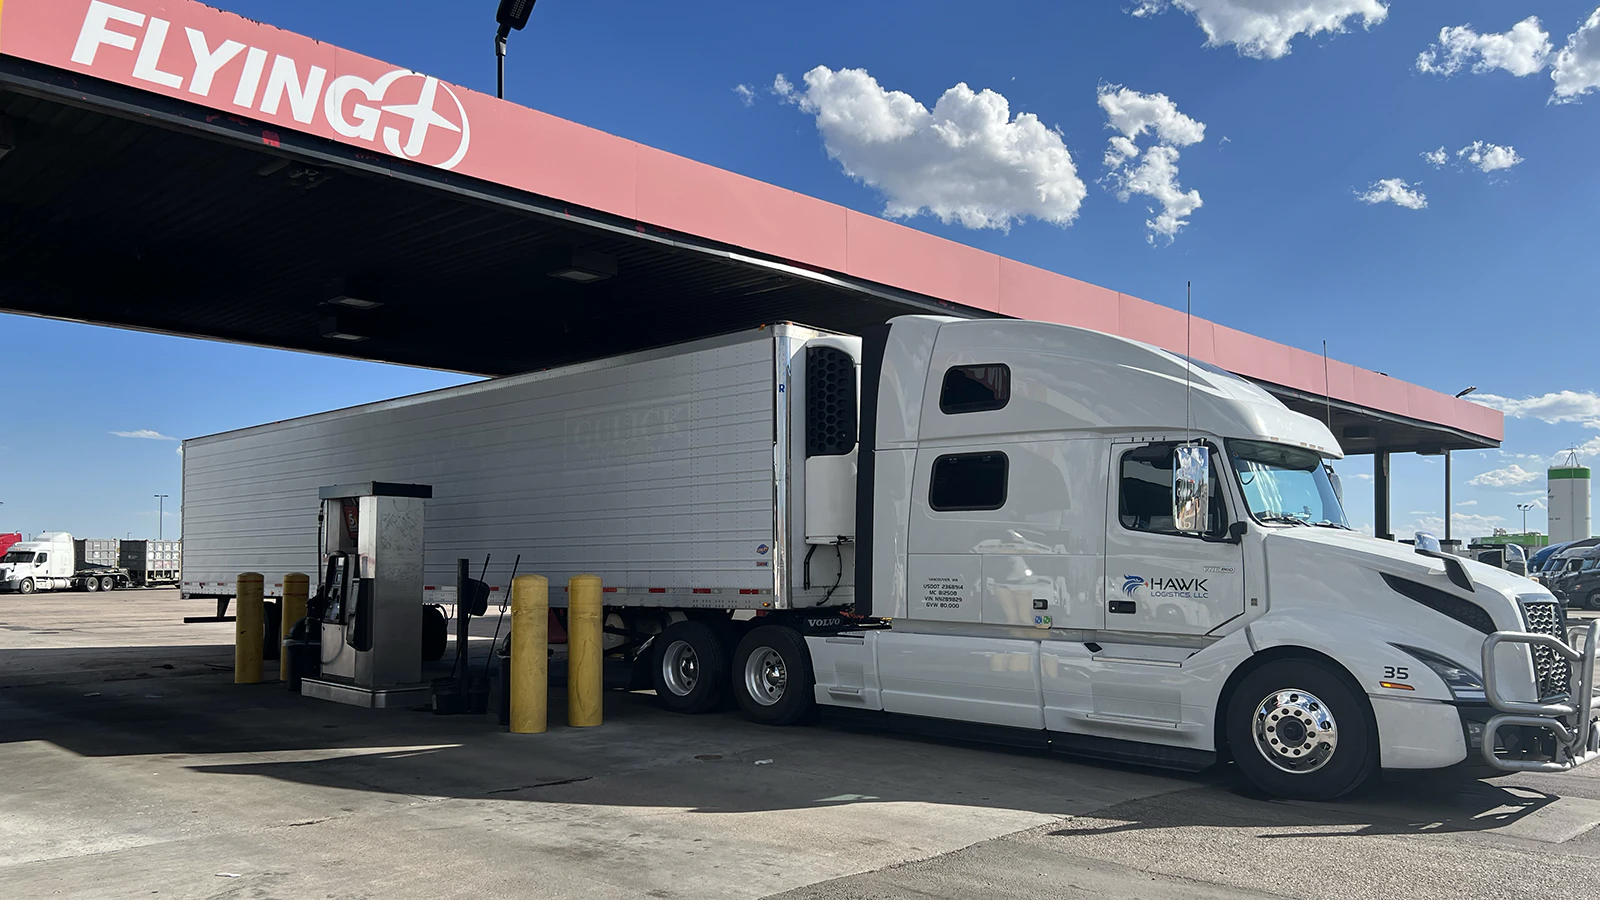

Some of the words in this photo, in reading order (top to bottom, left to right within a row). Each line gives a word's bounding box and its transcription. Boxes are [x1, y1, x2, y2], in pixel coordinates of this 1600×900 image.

[71, 0, 382, 142] FLYING
[779, 384, 785, 393] R
[1151, 577, 1208, 592] HAWK
[808, 619, 840, 627] VOLVO
[1384, 666, 1408, 679] 35
